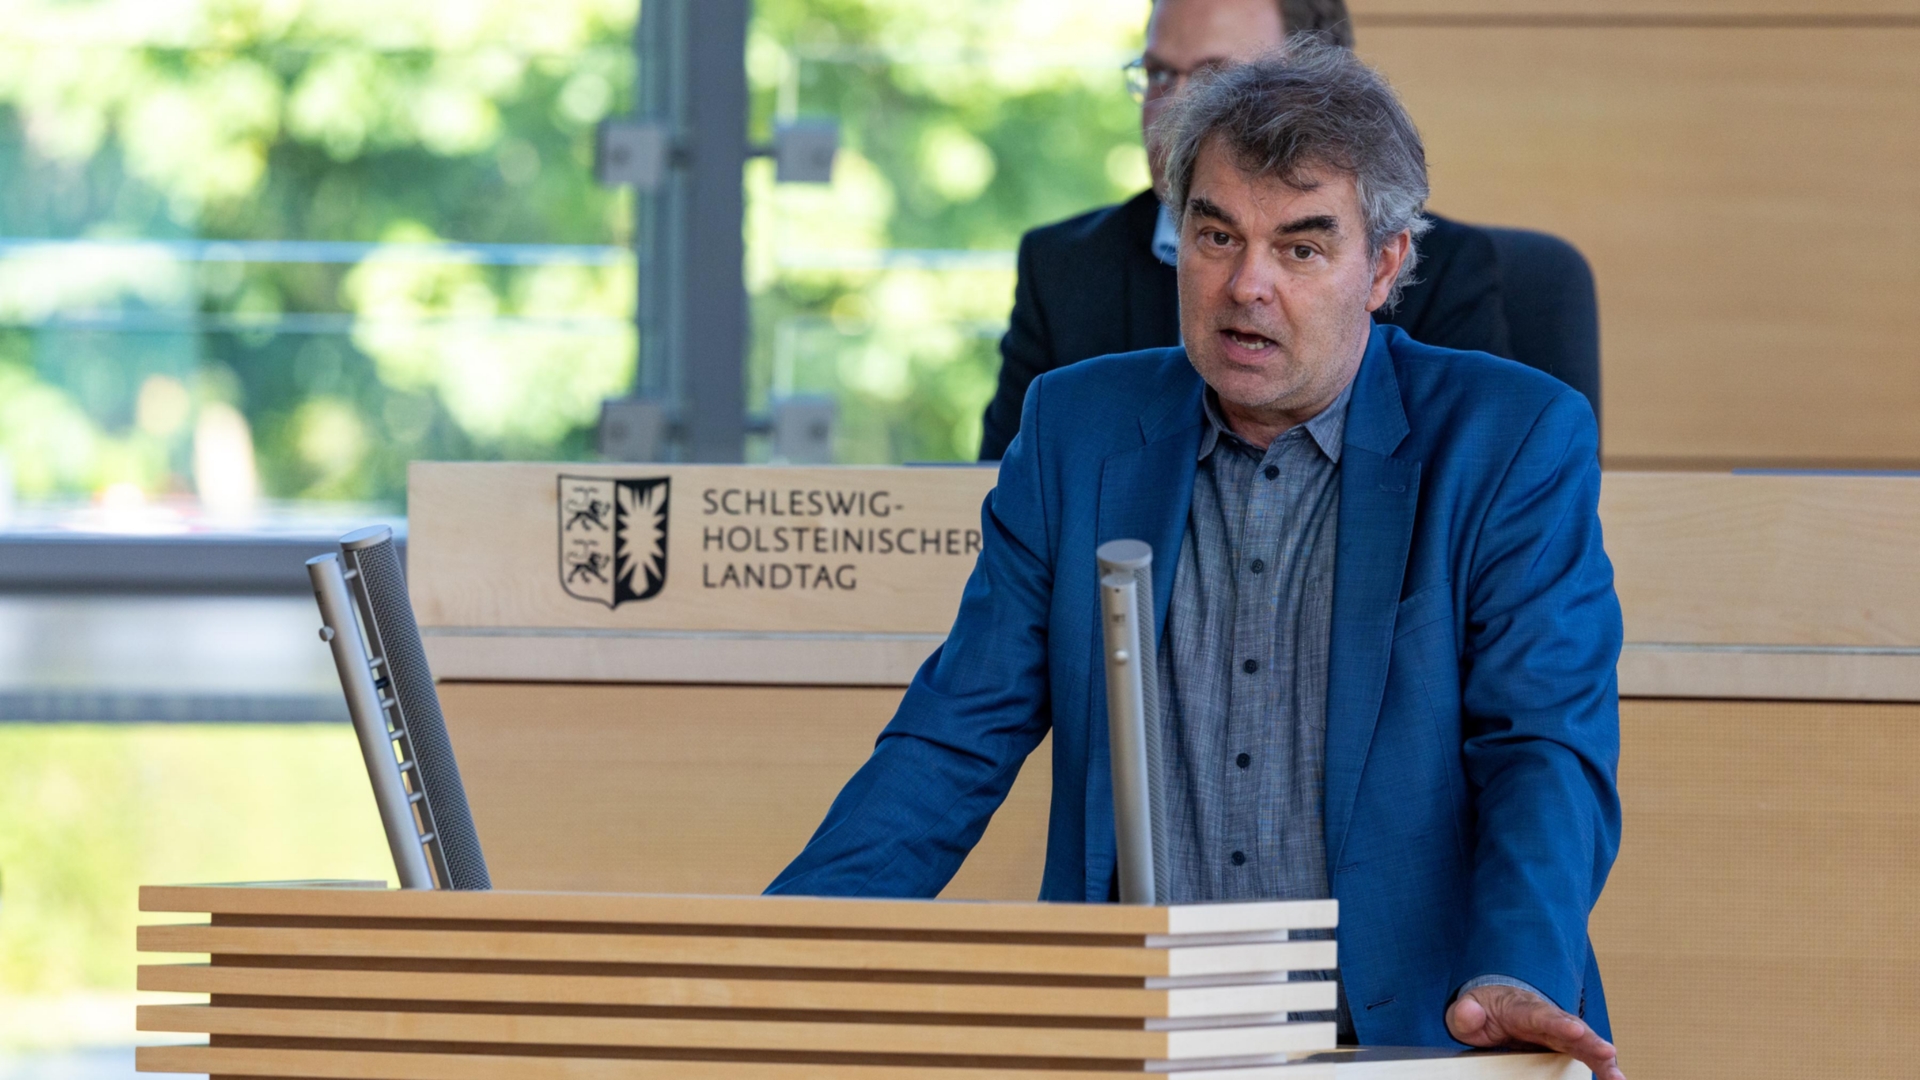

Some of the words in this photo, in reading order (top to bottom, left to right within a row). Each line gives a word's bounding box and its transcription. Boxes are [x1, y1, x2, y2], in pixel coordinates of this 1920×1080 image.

[703, 489, 904, 517] SCHLESWIG-
[703, 526, 982, 555] HOLSTEINISCHER
[703, 563, 857, 590] LANDTAG
